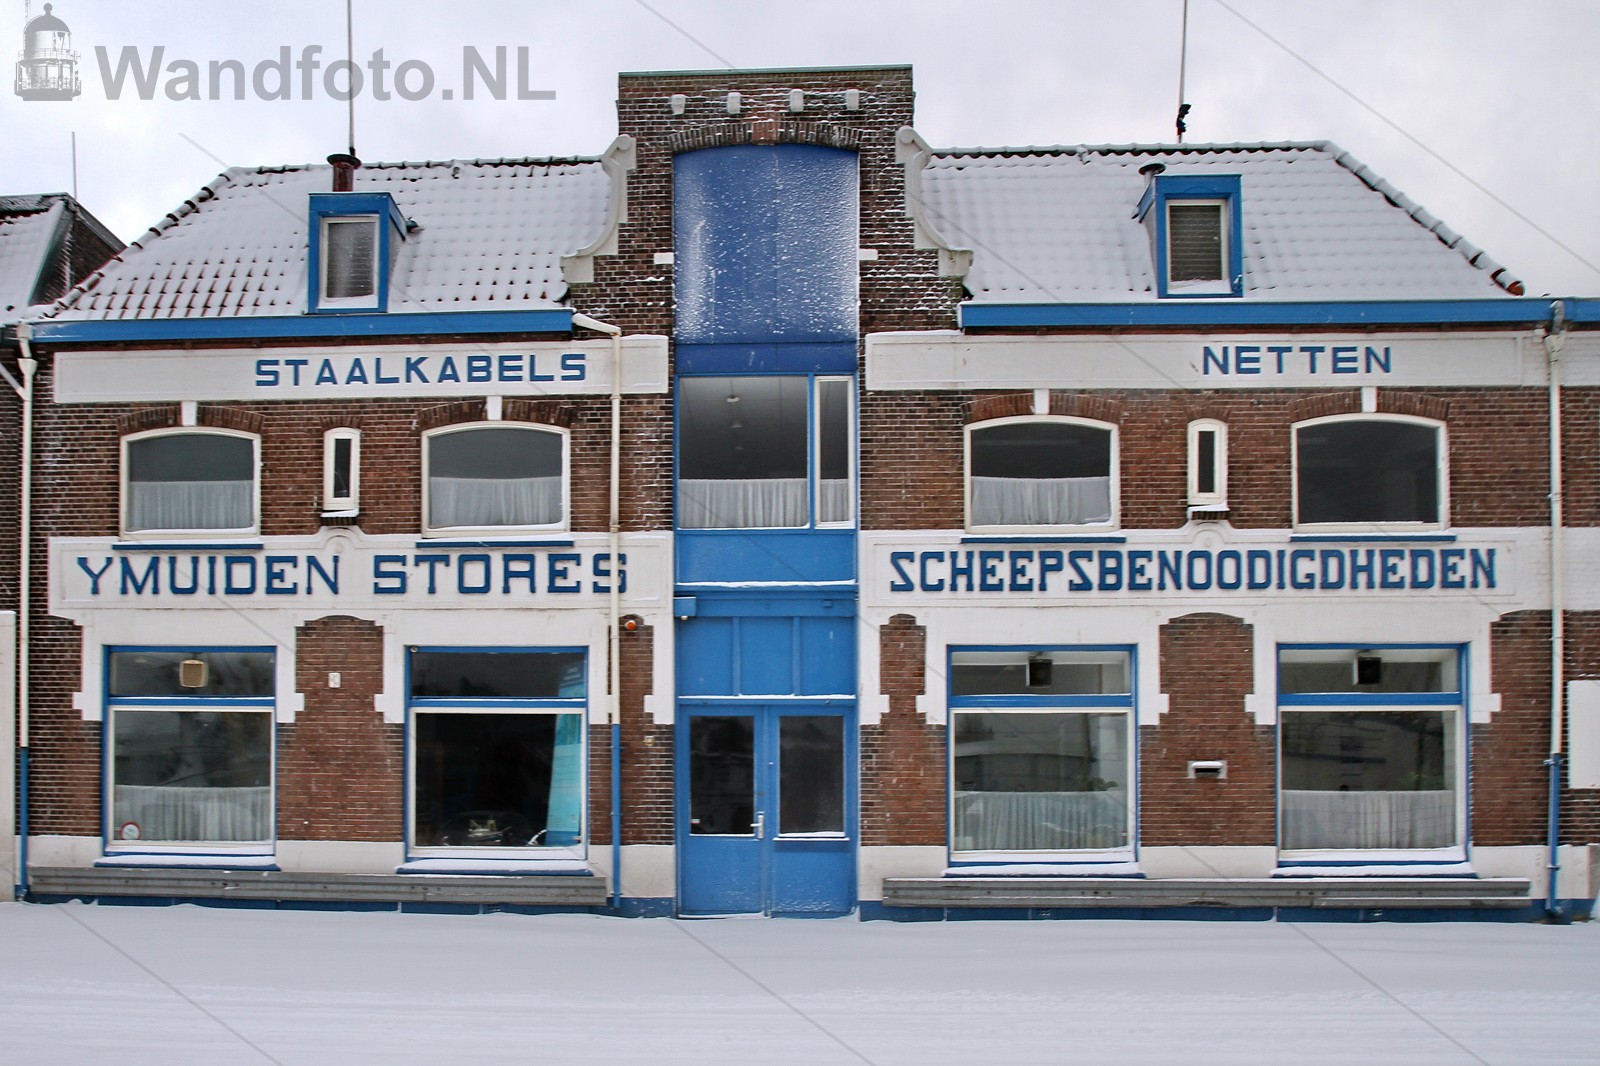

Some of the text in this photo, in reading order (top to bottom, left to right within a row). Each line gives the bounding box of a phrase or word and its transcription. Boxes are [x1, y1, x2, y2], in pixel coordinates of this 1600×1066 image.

[255, 353, 585, 387] STAALKABELS
[1204, 345, 1392, 375] NETTEN
[76, 553, 627, 595] YMUIDEN STORES
[890, 548, 1497, 593] SCHEEPSBENOODIGDHEDEN
